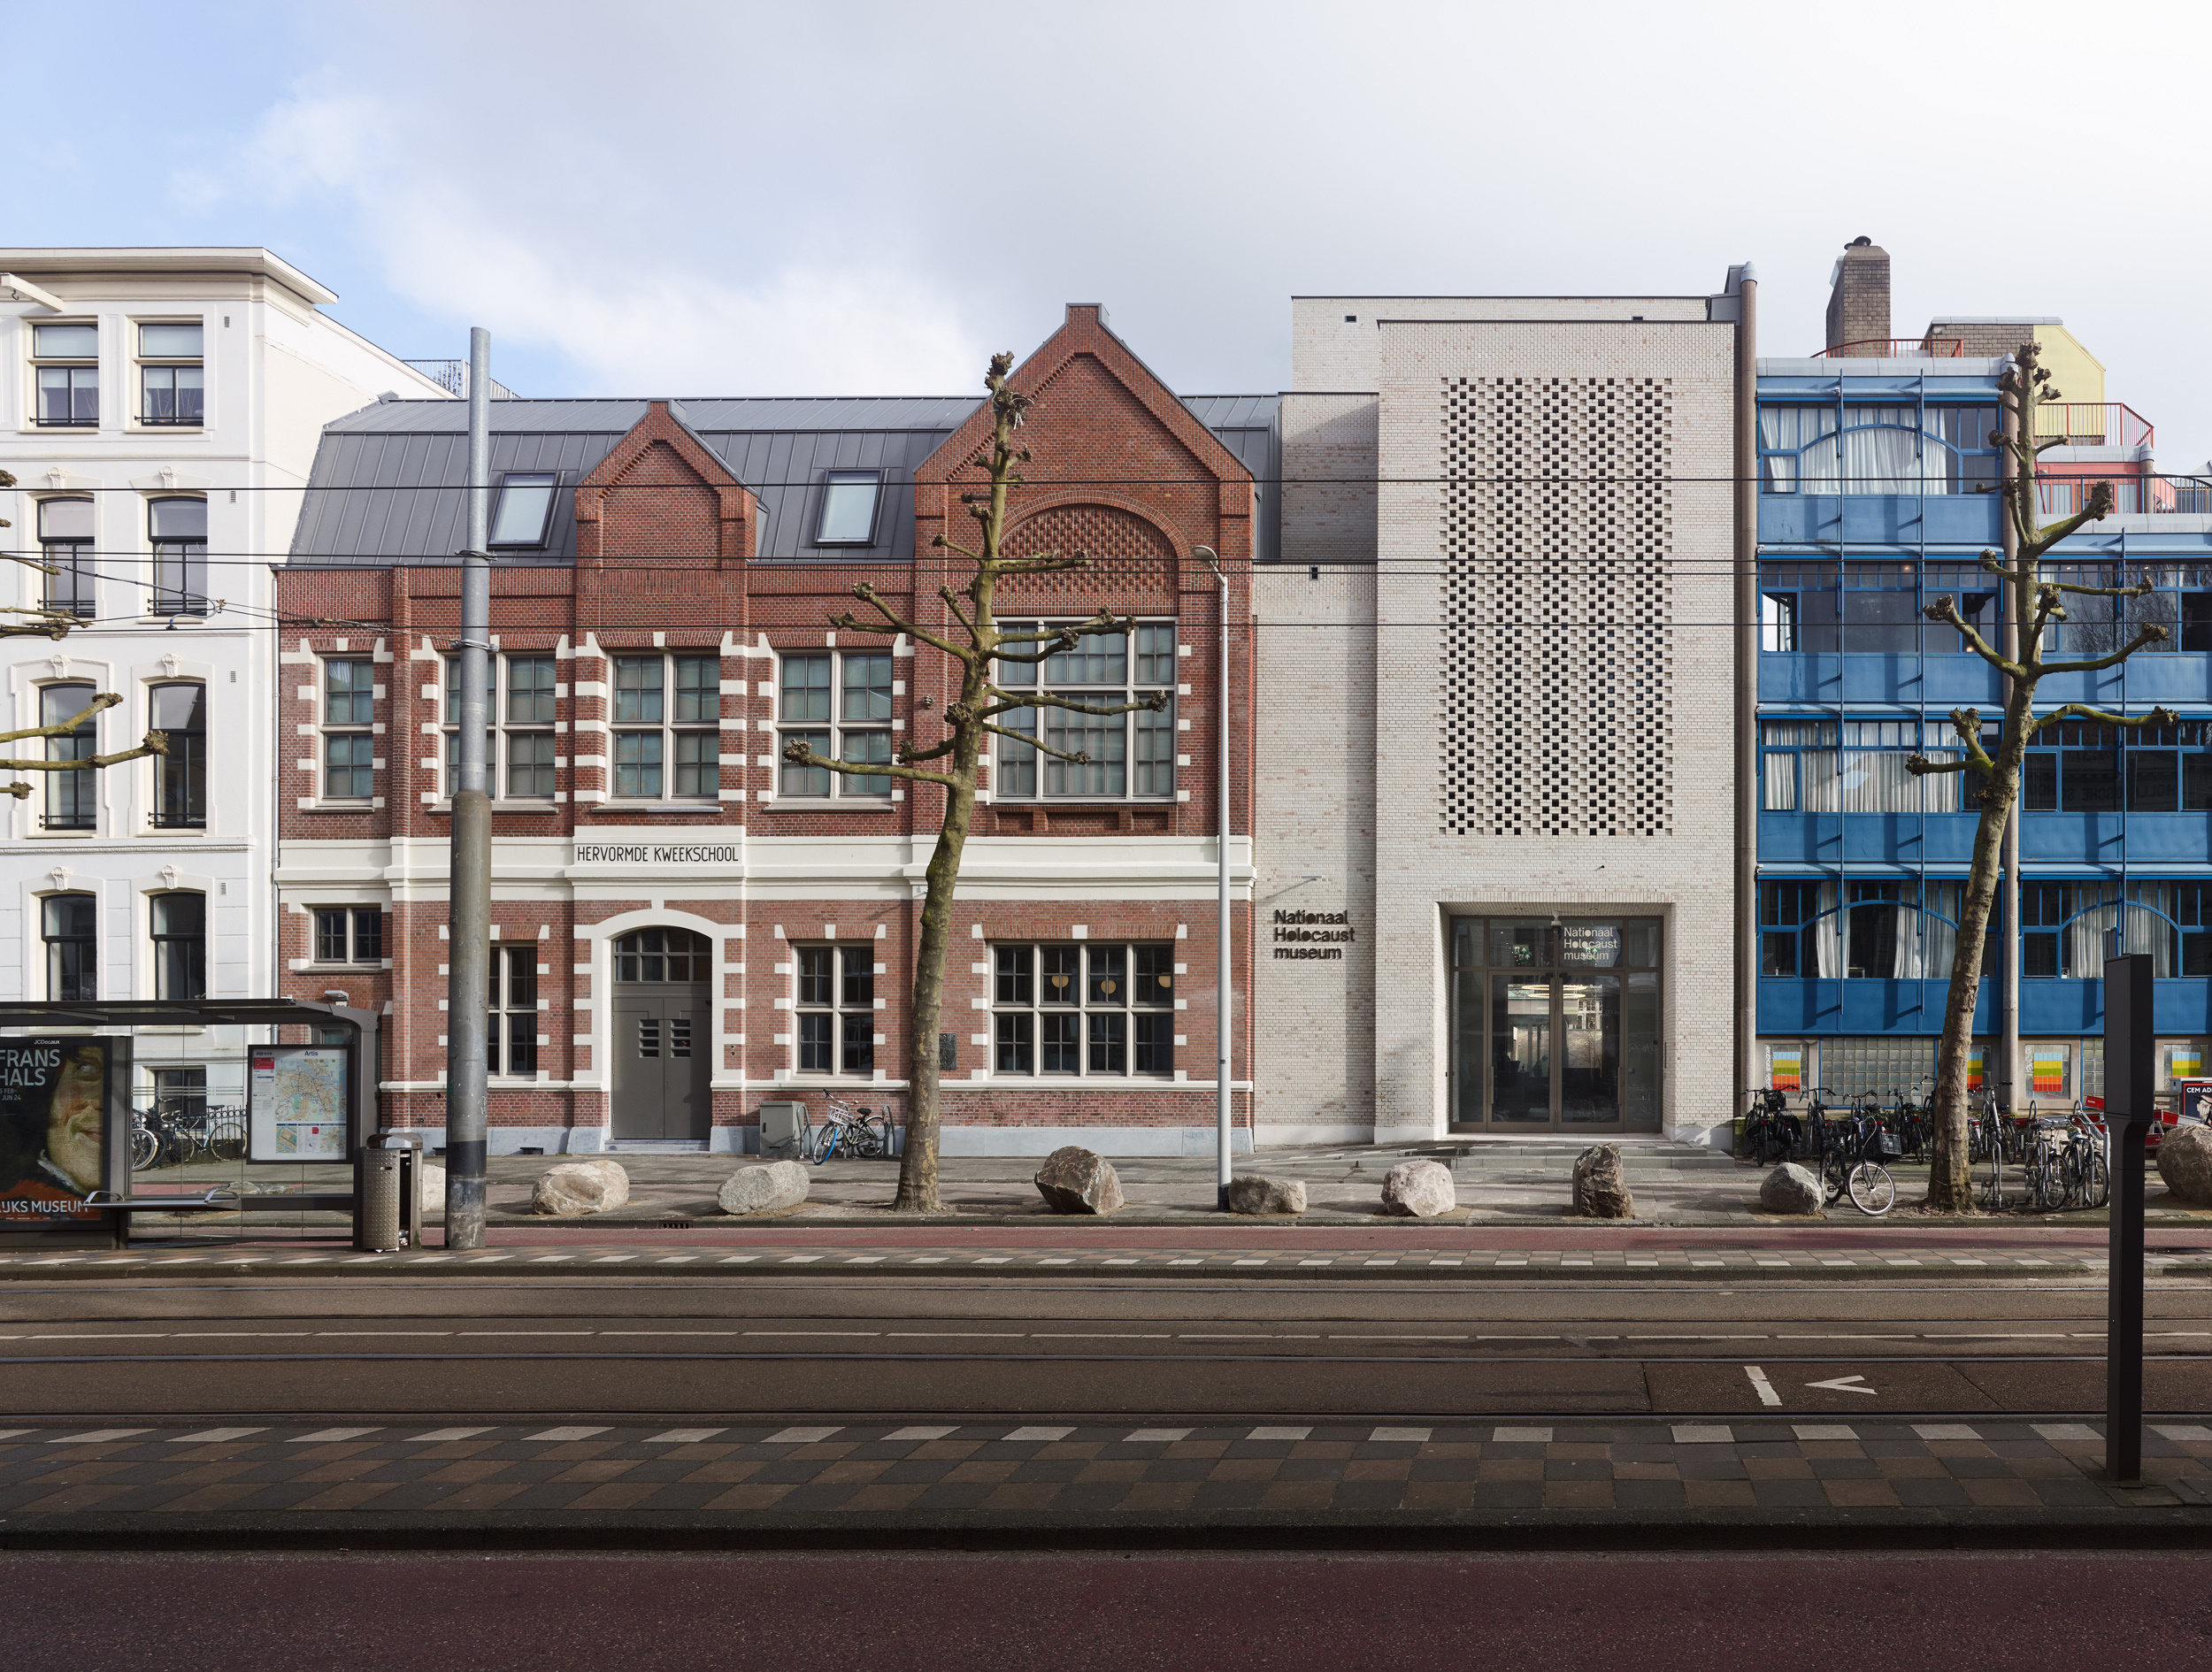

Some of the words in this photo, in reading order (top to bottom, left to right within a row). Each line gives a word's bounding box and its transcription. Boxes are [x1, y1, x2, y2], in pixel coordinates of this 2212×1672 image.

[577, 846, 649, 862] HERVORMDE
[654, 847, 739, 862] KWEEKSCHOOL
[1275, 909, 1349, 924] Nationaal
[1275, 927, 1356, 942] Holocaust
[1563, 927, 1614, 937] Nationaal
[1563, 939, 1617, 948] Holocaust
[1275, 947, 1342, 959] museum
